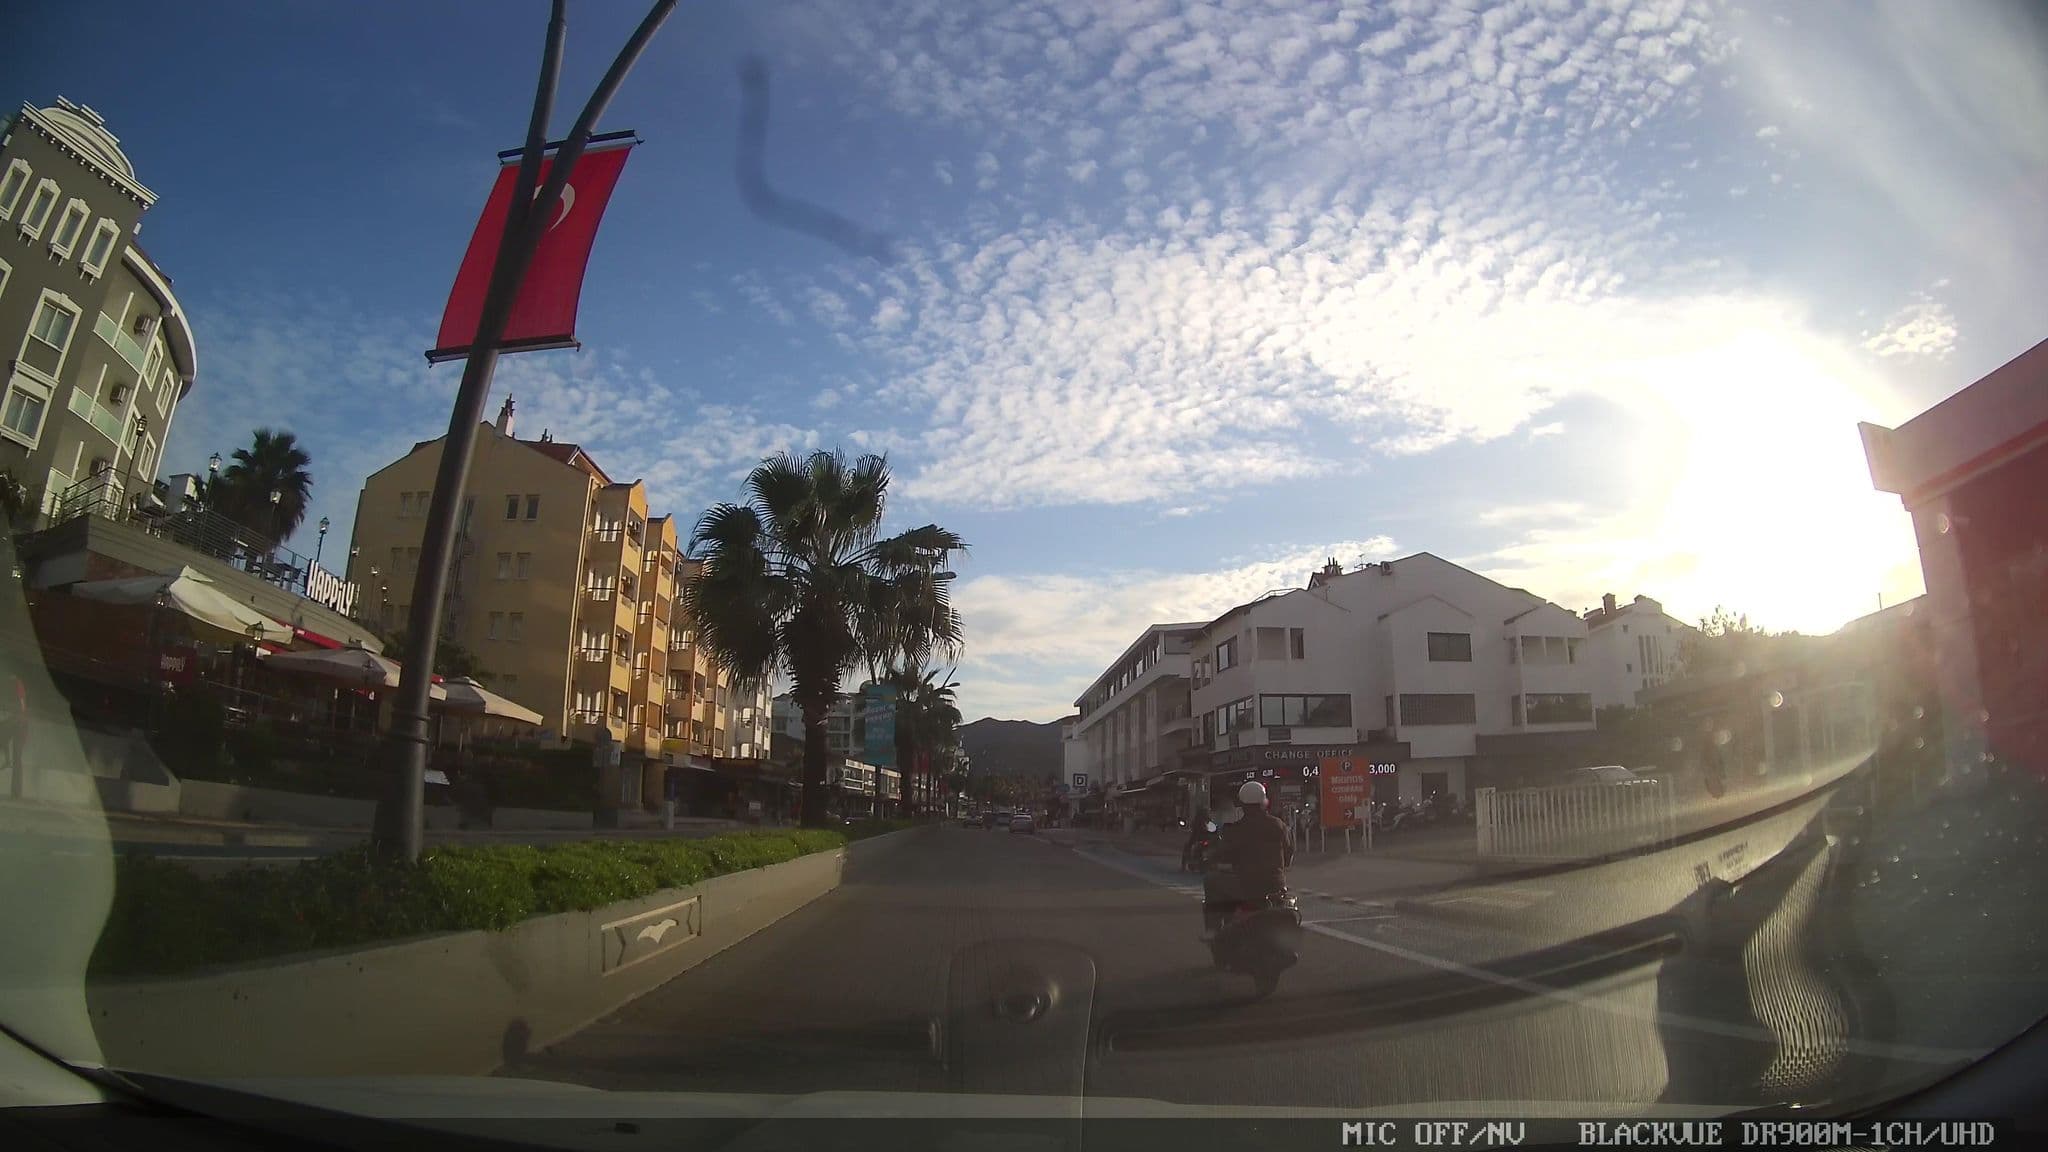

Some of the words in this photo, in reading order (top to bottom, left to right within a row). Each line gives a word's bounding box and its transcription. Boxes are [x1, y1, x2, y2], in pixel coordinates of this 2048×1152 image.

[1264, 750, 1310, 760] CHANGE
[1317, 749, 1353, 759] OFFICE
[1344, 761, 1351, 771] P
[1369, 763, 1396, 775] 3,000
